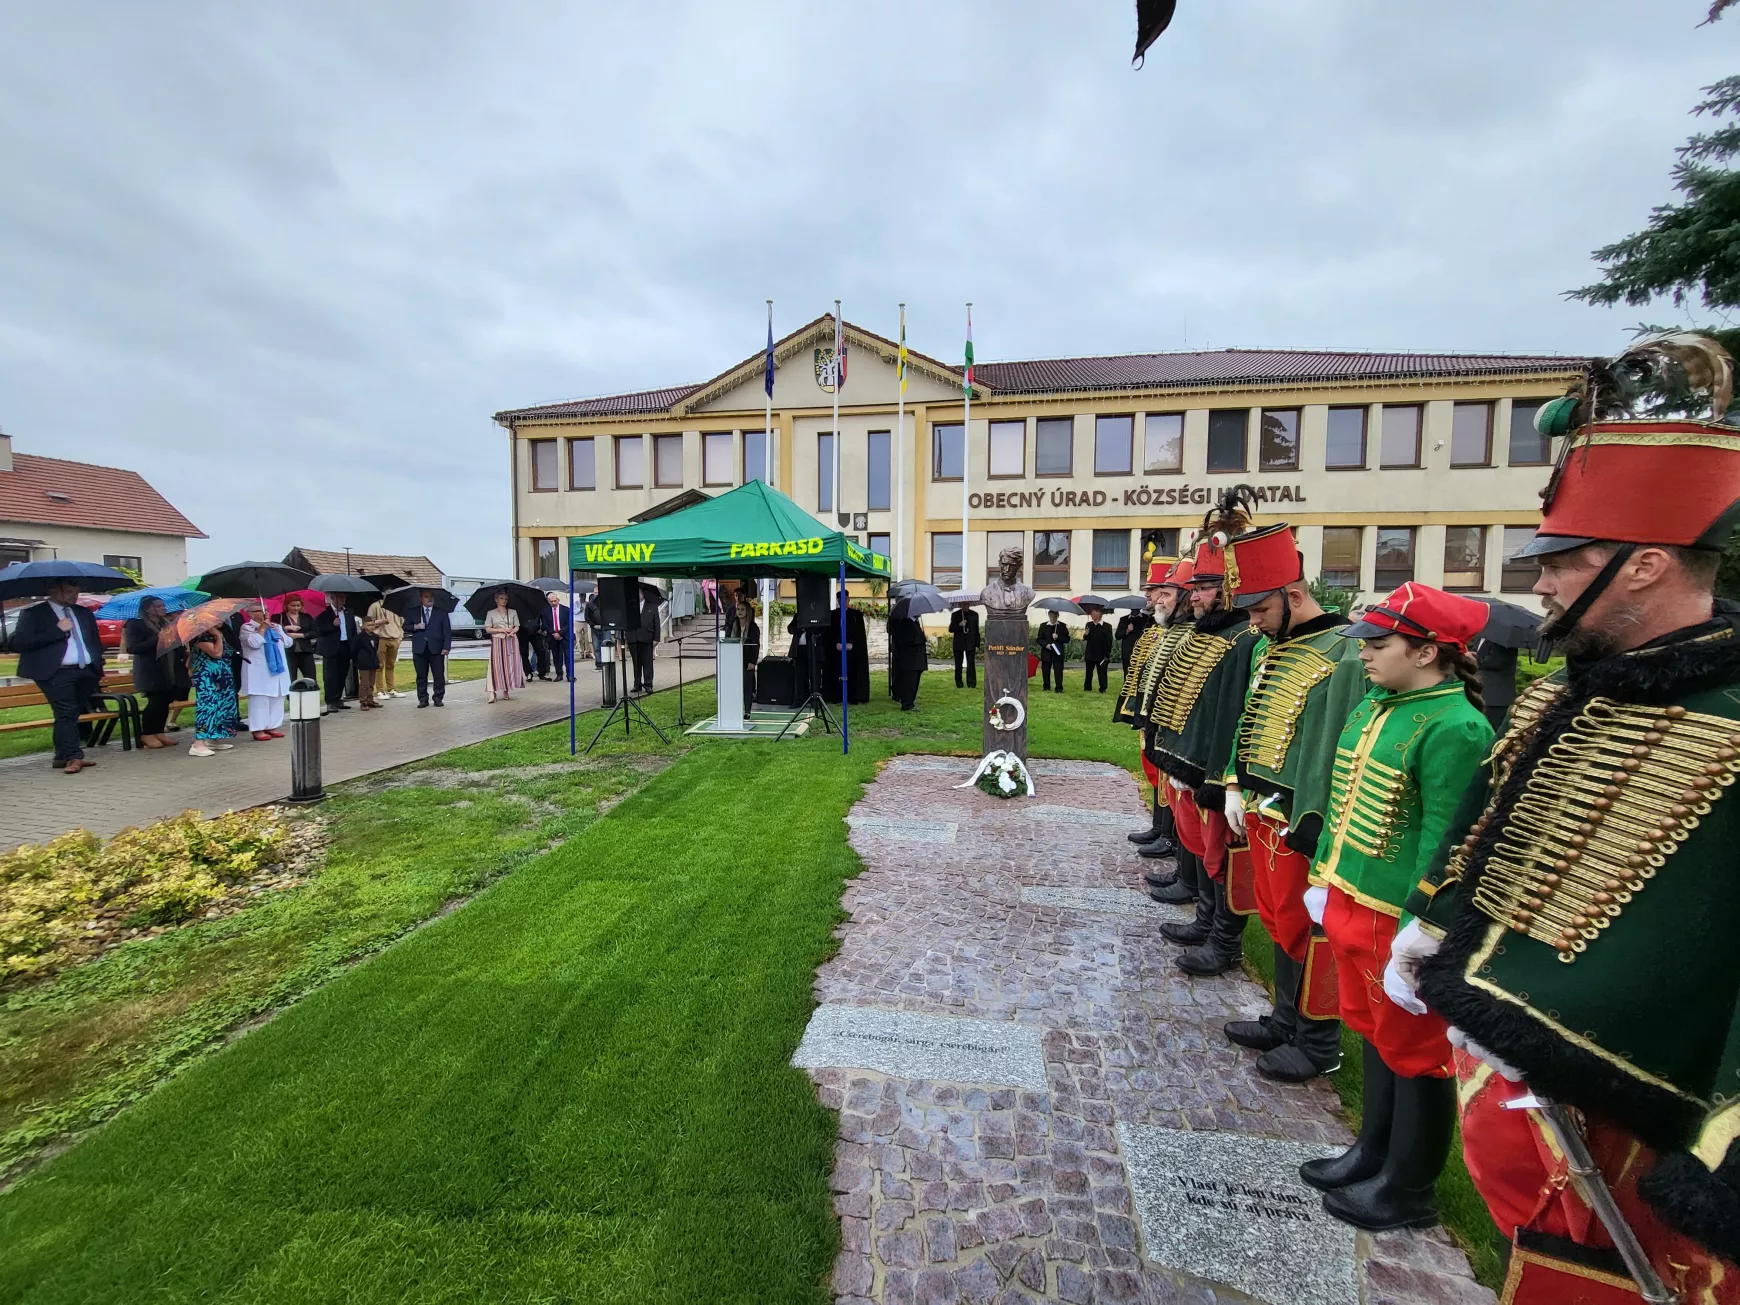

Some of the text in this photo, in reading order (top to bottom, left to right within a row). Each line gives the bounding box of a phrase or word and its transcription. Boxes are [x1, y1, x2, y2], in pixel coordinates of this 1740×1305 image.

[969, 487, 1046, 509] OBECNÝ
[1051, 486, 1107, 507] ÚRAD
[1123, 483, 1211, 506] KÖZSÉGI
[584, 540, 656, 562] VLČANY
[729, 537, 824, 559] FARKASD
[1241, 1183, 1266, 1200] len
[1186, 1192, 1215, 1208] kde
[1245, 1202, 1261, 1218] aj
[1264, 1206, 1312, 1223] práva
